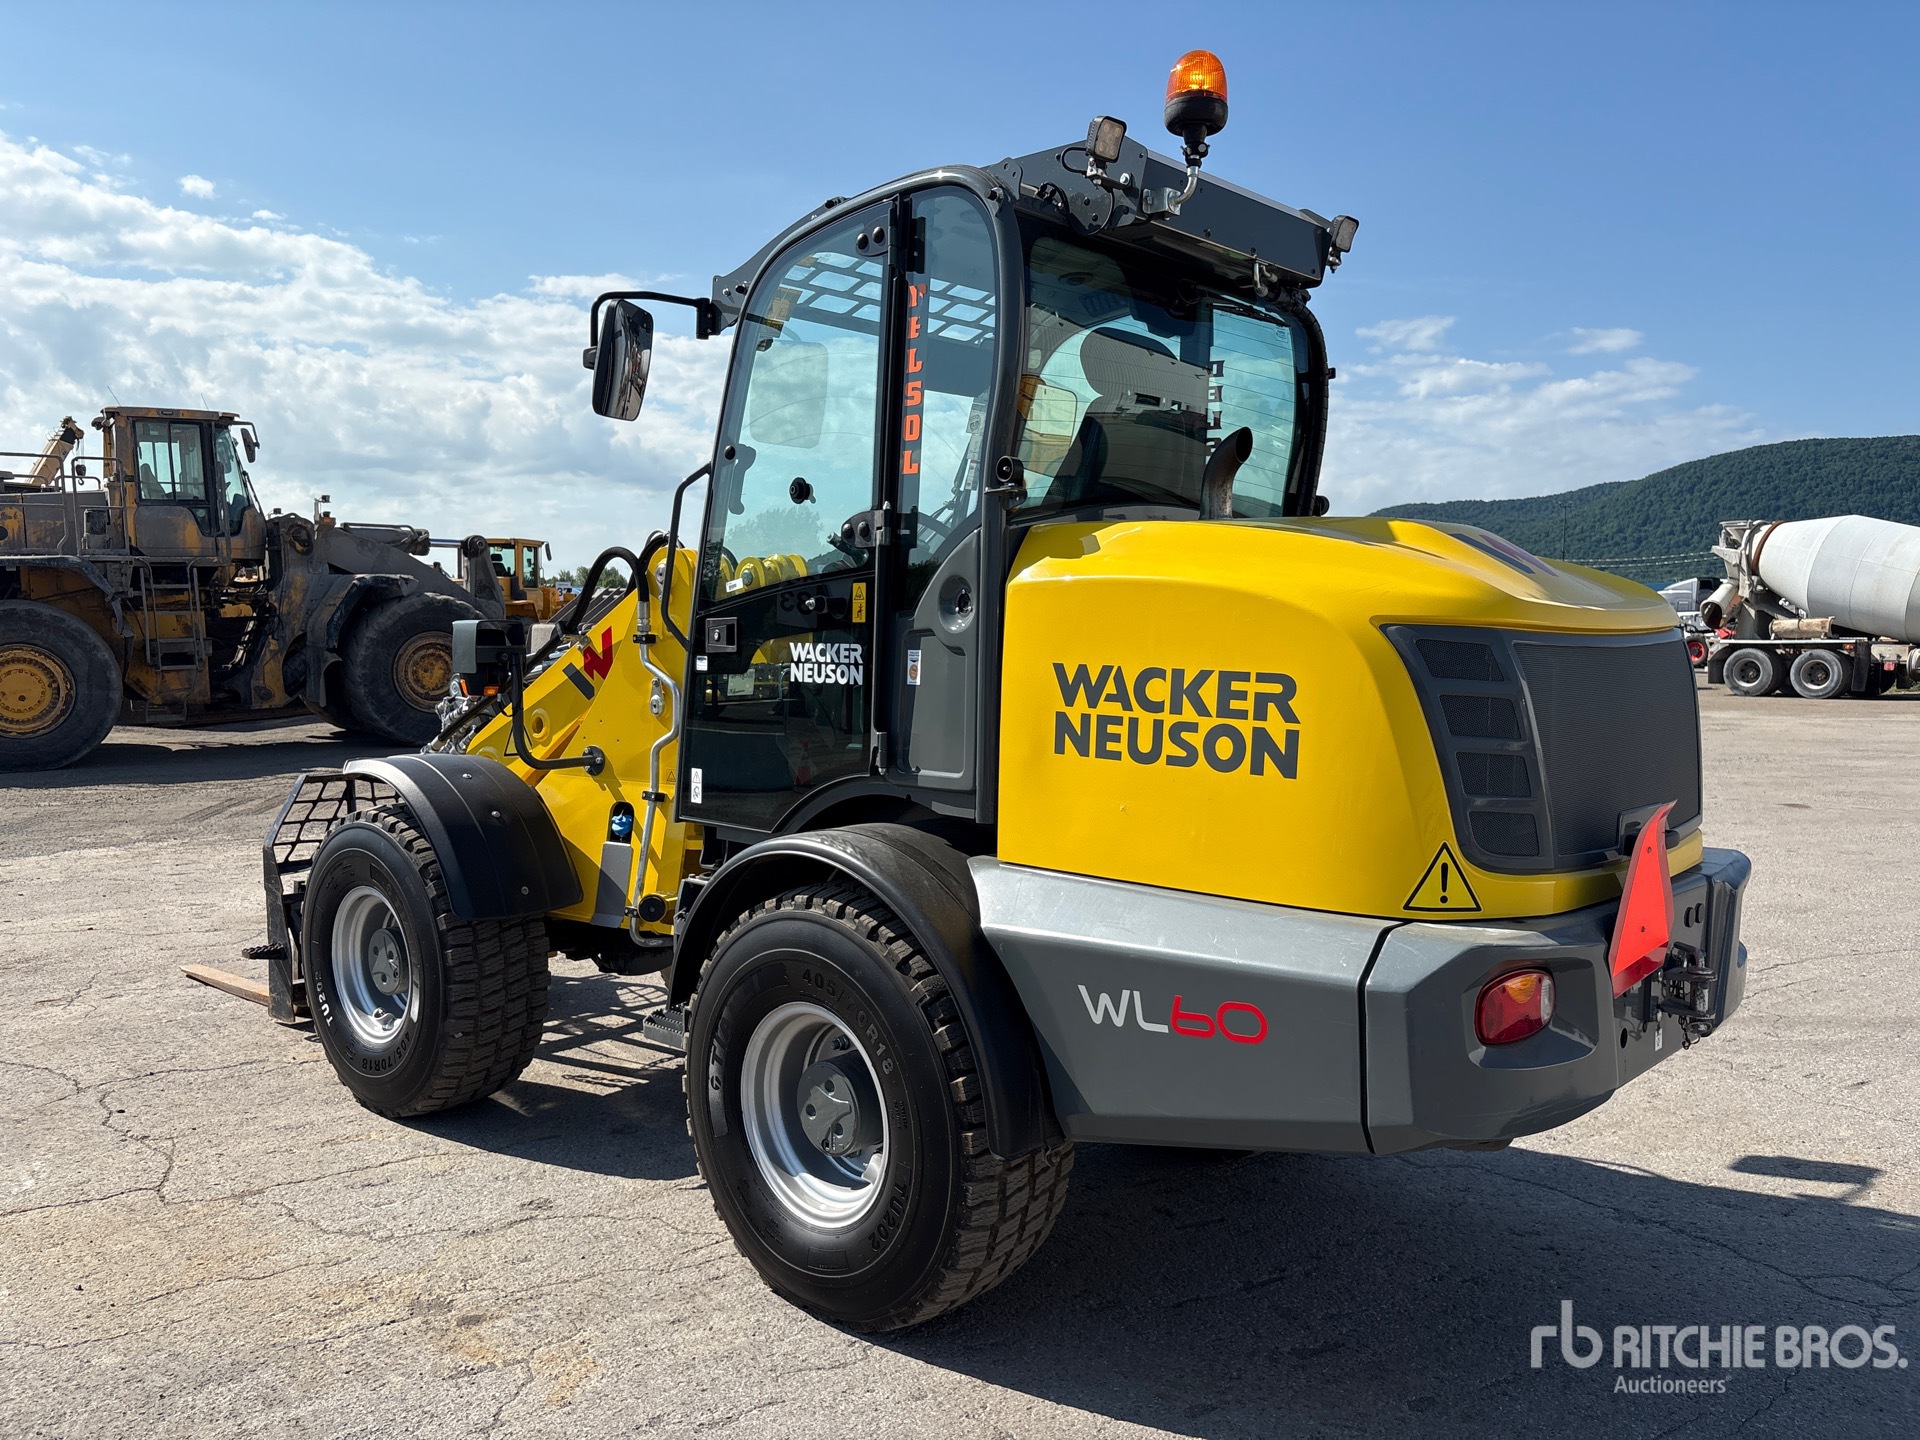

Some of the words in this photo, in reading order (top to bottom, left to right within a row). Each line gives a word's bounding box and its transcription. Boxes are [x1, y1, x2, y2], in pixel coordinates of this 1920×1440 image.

[789, 642, 864, 664] WACKER
[790, 662, 864, 686] NEUSON
[1052, 662, 1301, 724] WACKER
[1054, 710, 1300, 780] NEUSON
[1077, 984, 1269, 1045] WL60
